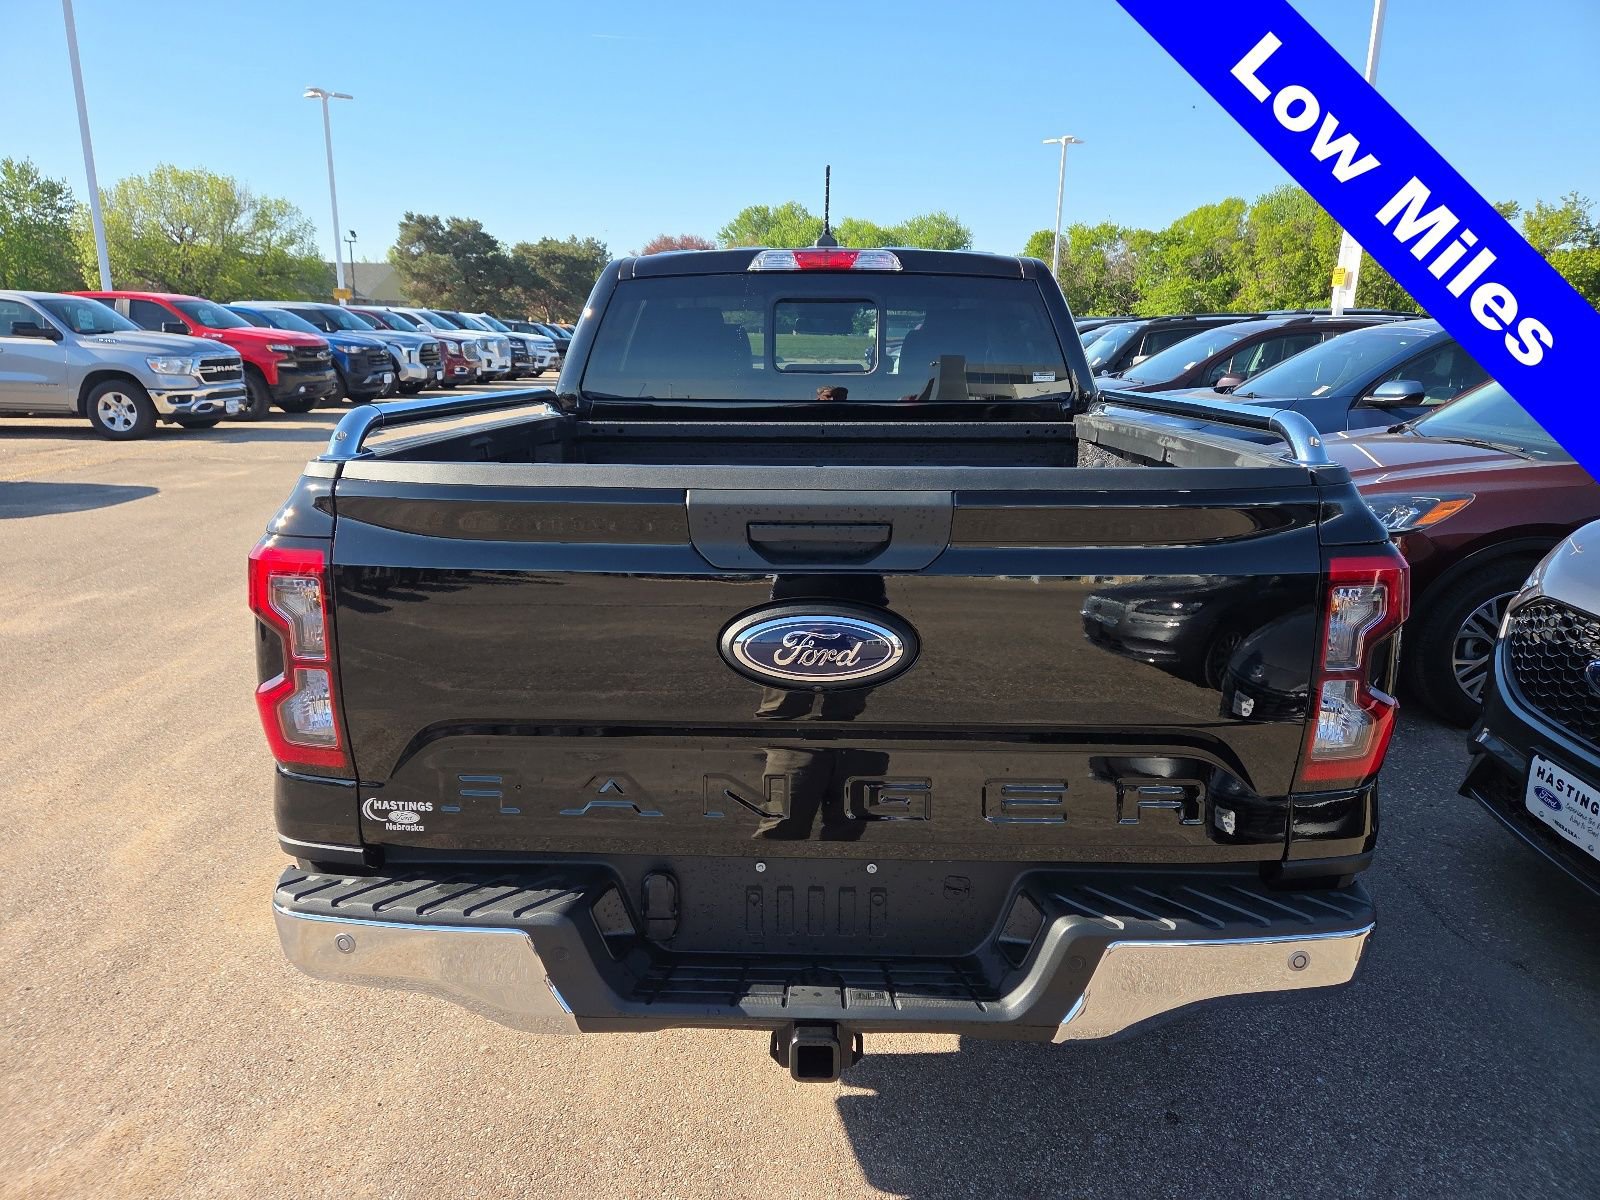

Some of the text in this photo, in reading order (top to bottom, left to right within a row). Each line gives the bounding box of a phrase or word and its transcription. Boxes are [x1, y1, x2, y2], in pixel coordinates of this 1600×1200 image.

[773, 630, 863, 667] Ford
[373, 799, 434, 812] HASTINGS
[440, 772, 1205, 825] RANGER
[1539, 789, 1558, 809] Ford
[385, 822, 425, 832] Nebraska
